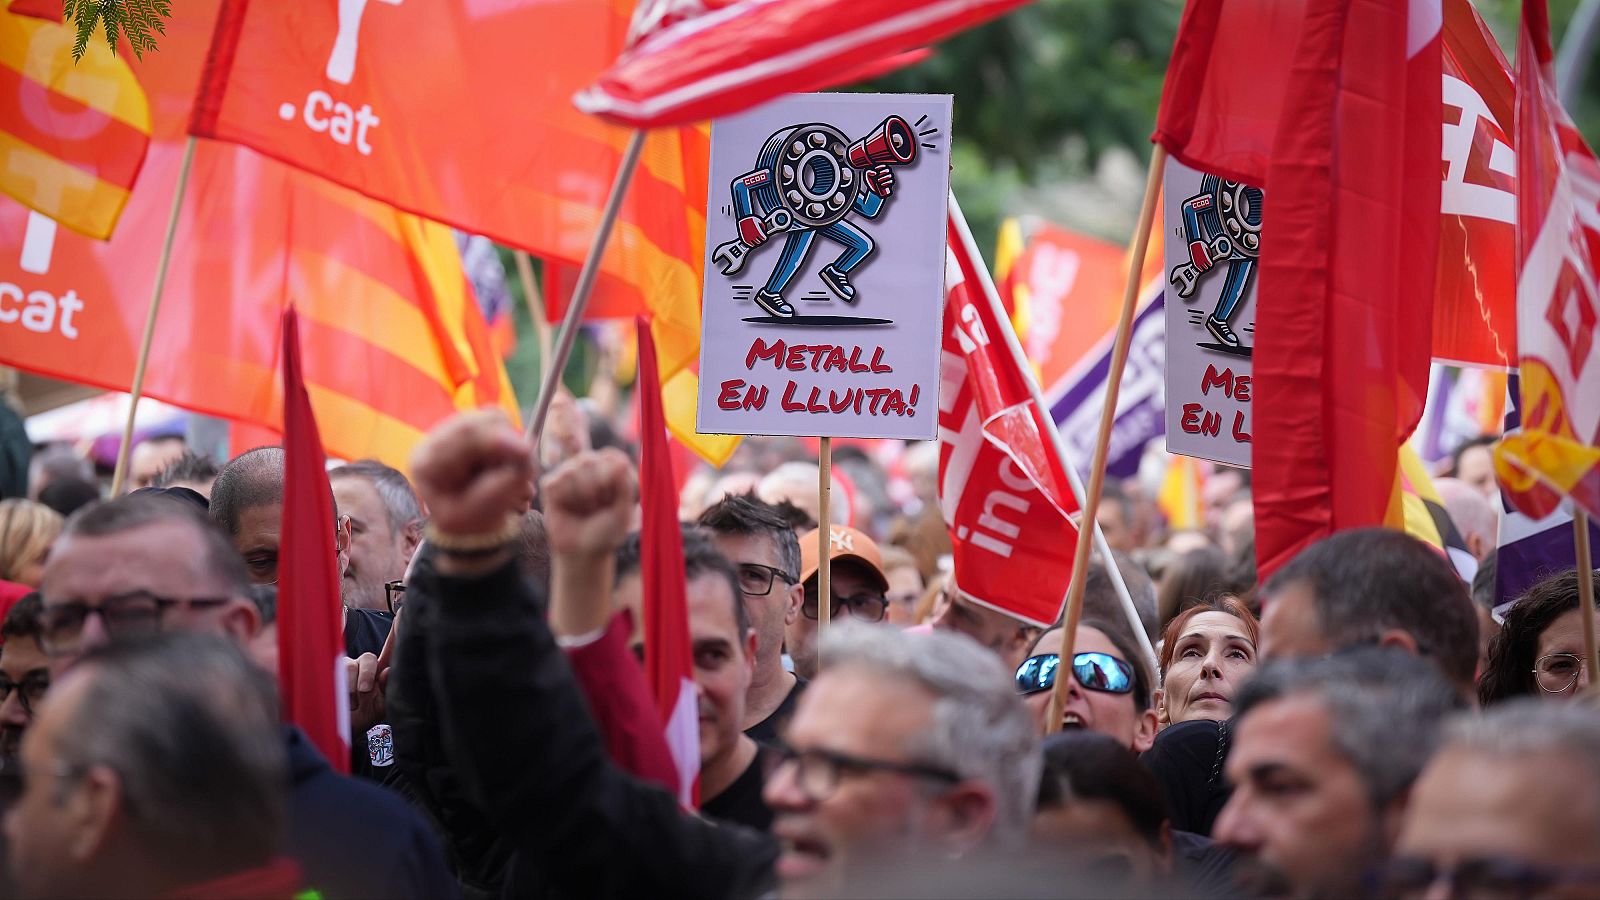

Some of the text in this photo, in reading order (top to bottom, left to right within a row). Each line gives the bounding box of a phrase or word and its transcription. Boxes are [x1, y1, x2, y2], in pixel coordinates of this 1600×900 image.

[745, 337, 893, 373] METALL
[717, 379, 920, 417] EN LLUITA!
[1181, 403, 1222, 437] EN
